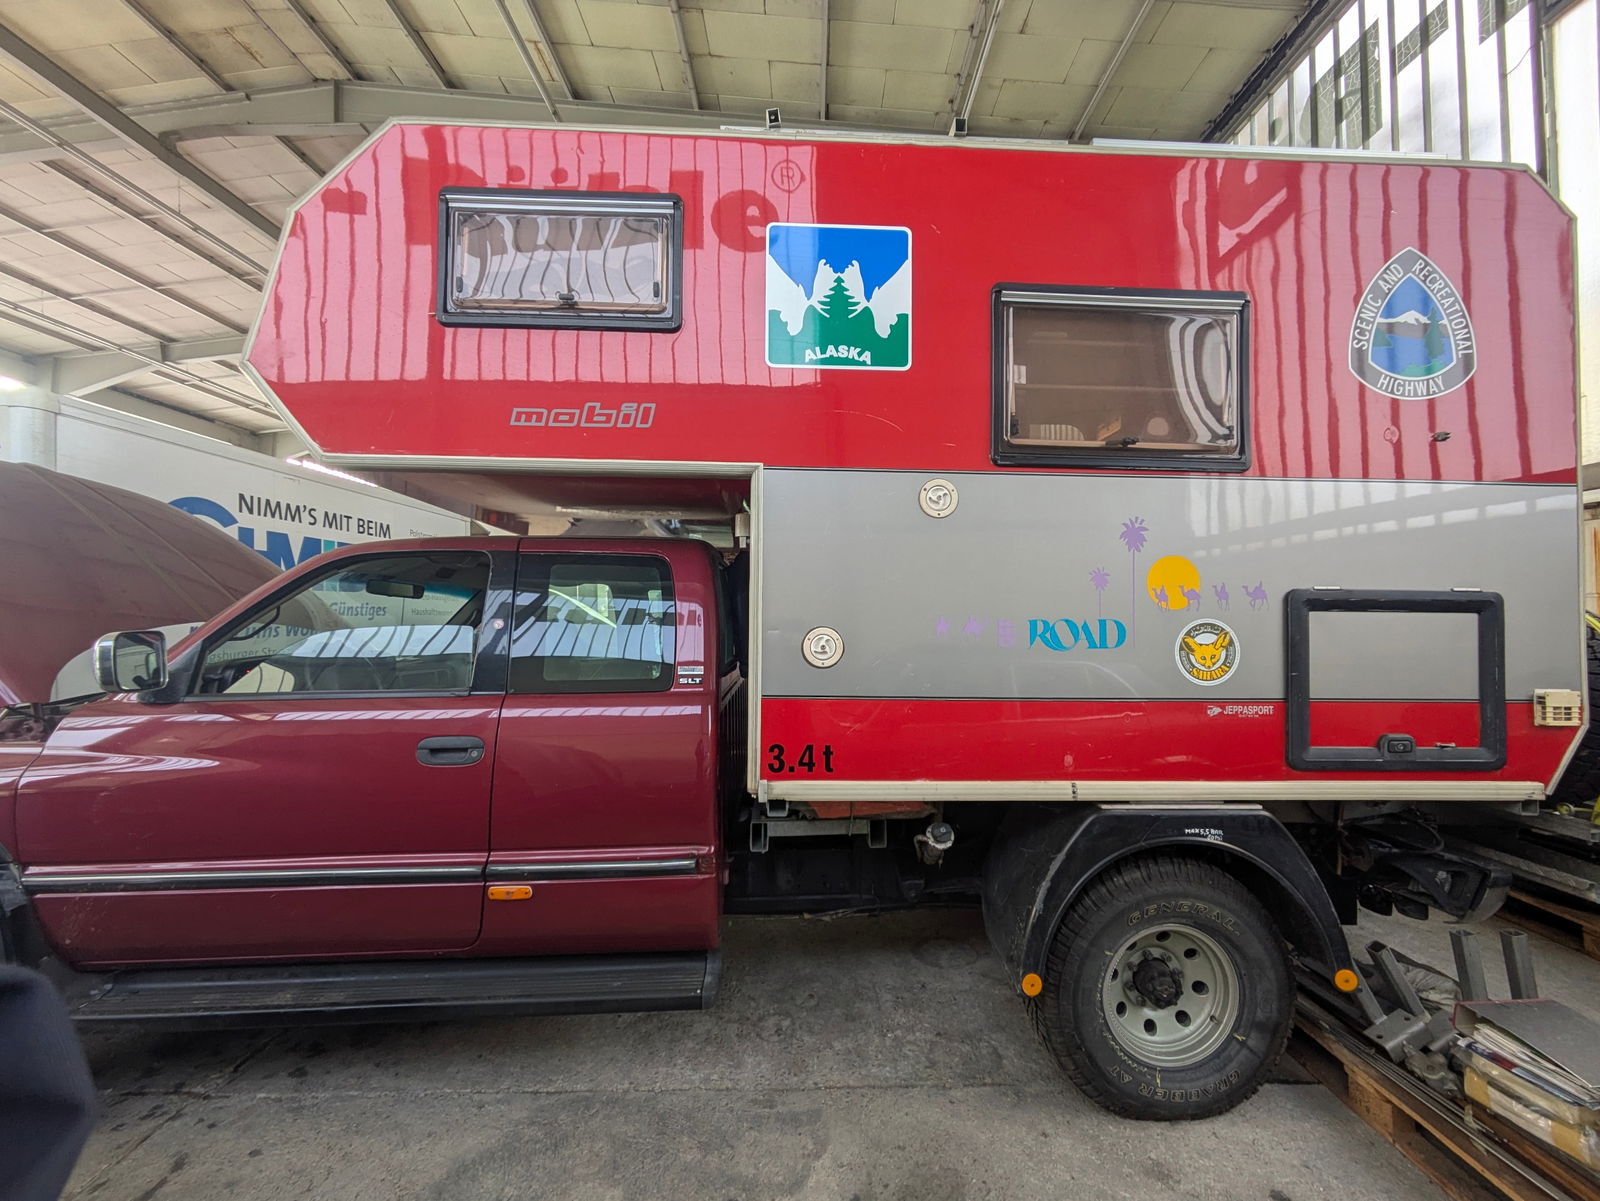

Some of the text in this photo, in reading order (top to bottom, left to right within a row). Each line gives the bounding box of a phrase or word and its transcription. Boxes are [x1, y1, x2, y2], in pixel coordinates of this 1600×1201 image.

[1353, 258, 1473, 359] SCENIC AND RECREATIONAL
[804, 344, 872, 365] ALASKA
[1377, 373, 1445, 397] HIGHWAY
[510, 402, 656, 428] mobil
[238, 492, 392, 539] NIMM'S MIT BEIM
[1027, 618, 1127, 652] ROAD
[1191, 665, 1230, 681] SAHARA
[1223, 705, 1274, 715] JEPPASPORT
[767, 744, 834, 773] 3.4 t
[1128, 901, 1234, 931] GENERAL
[1110, 1064, 1241, 1102] GRABBER AT
